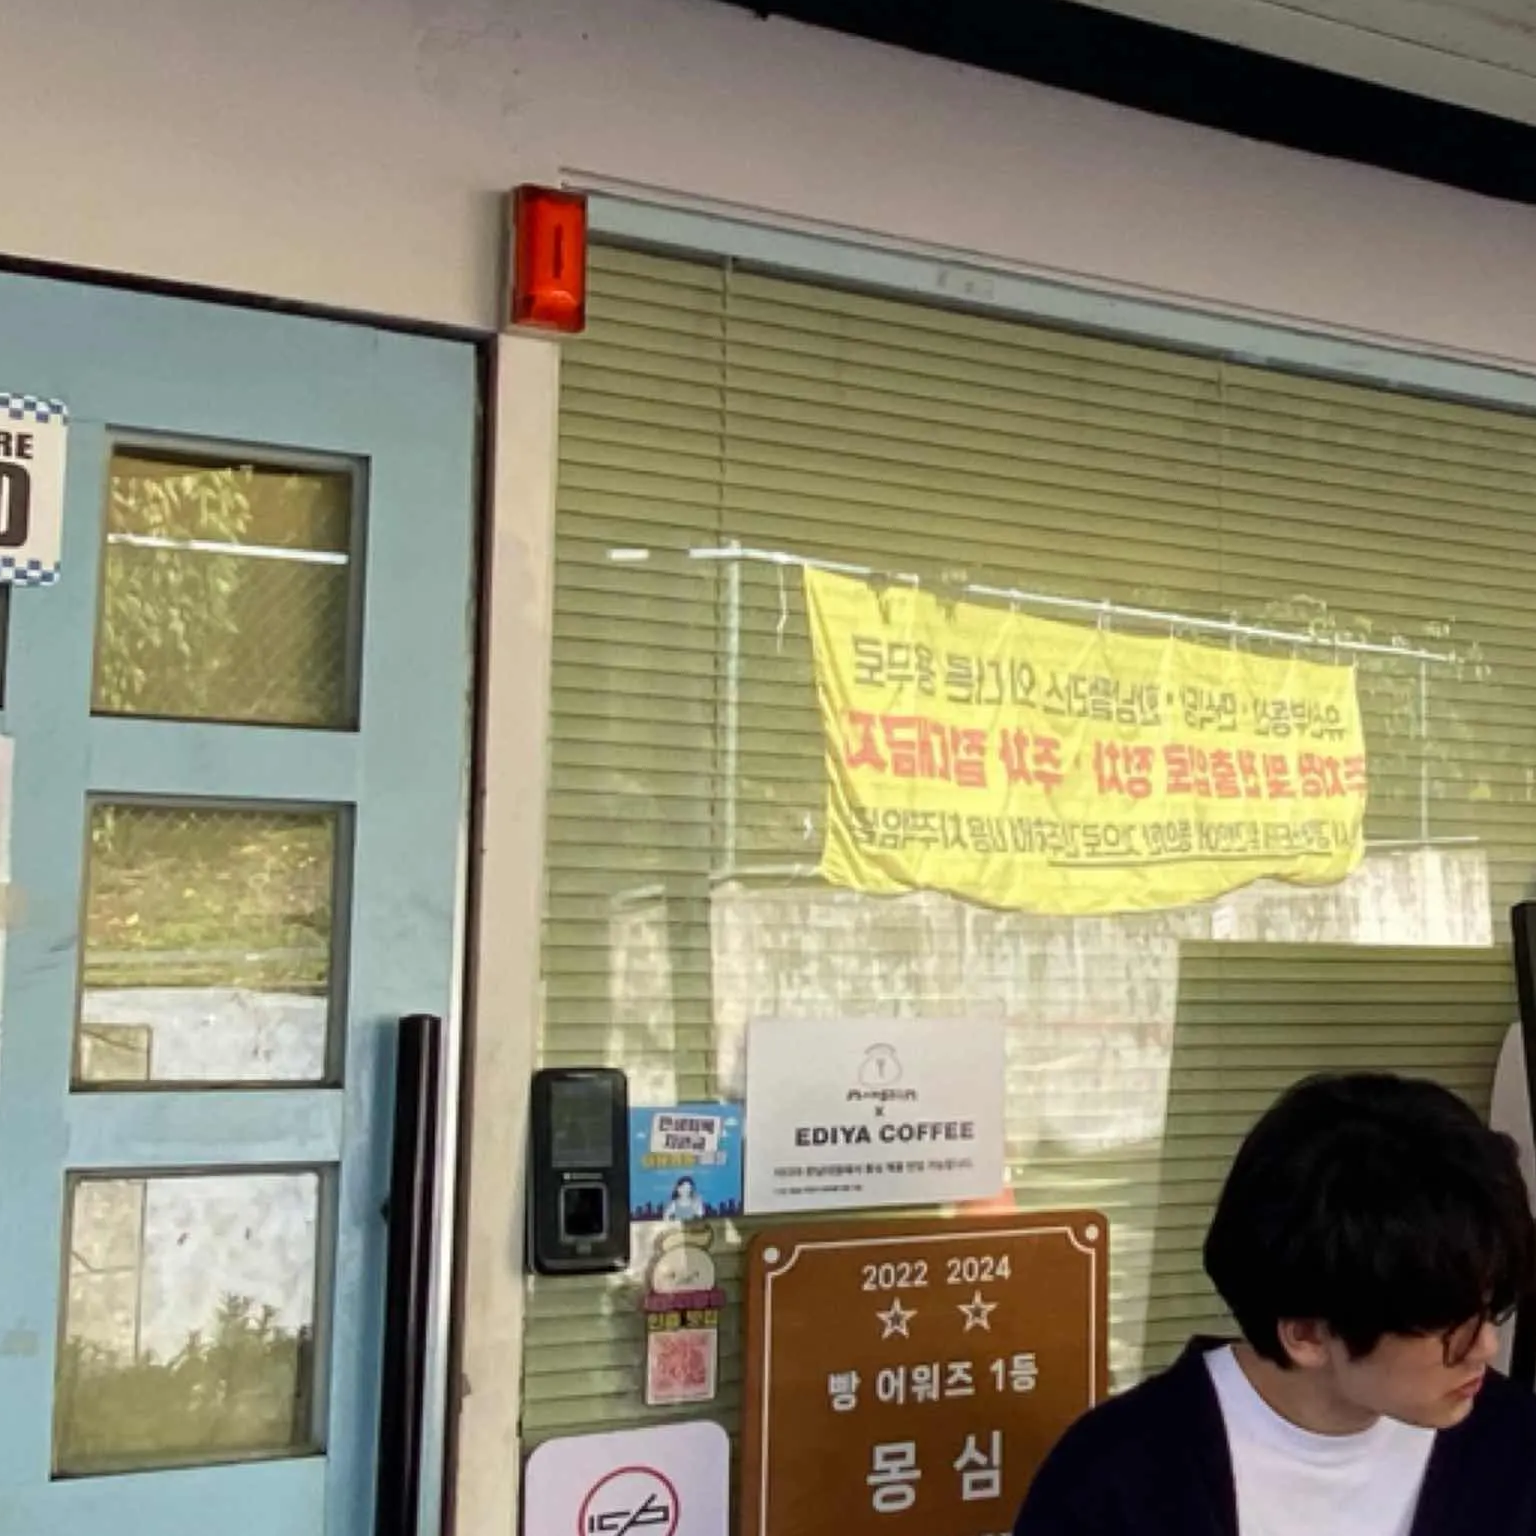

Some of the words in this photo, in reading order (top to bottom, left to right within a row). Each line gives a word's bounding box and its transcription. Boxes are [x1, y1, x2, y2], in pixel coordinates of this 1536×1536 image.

[794, 1125, 871, 1147] EDIYA
[878, 1121, 976, 1144] COFFEE
[862, 1261, 929, 1293] 2022
[946, 1254, 1012, 1286] 2024
[827, 1370, 862, 1412] 빵
[875, 1359, 976, 1405] 어워즈
[990, 1352, 1040, 1393] 1등
